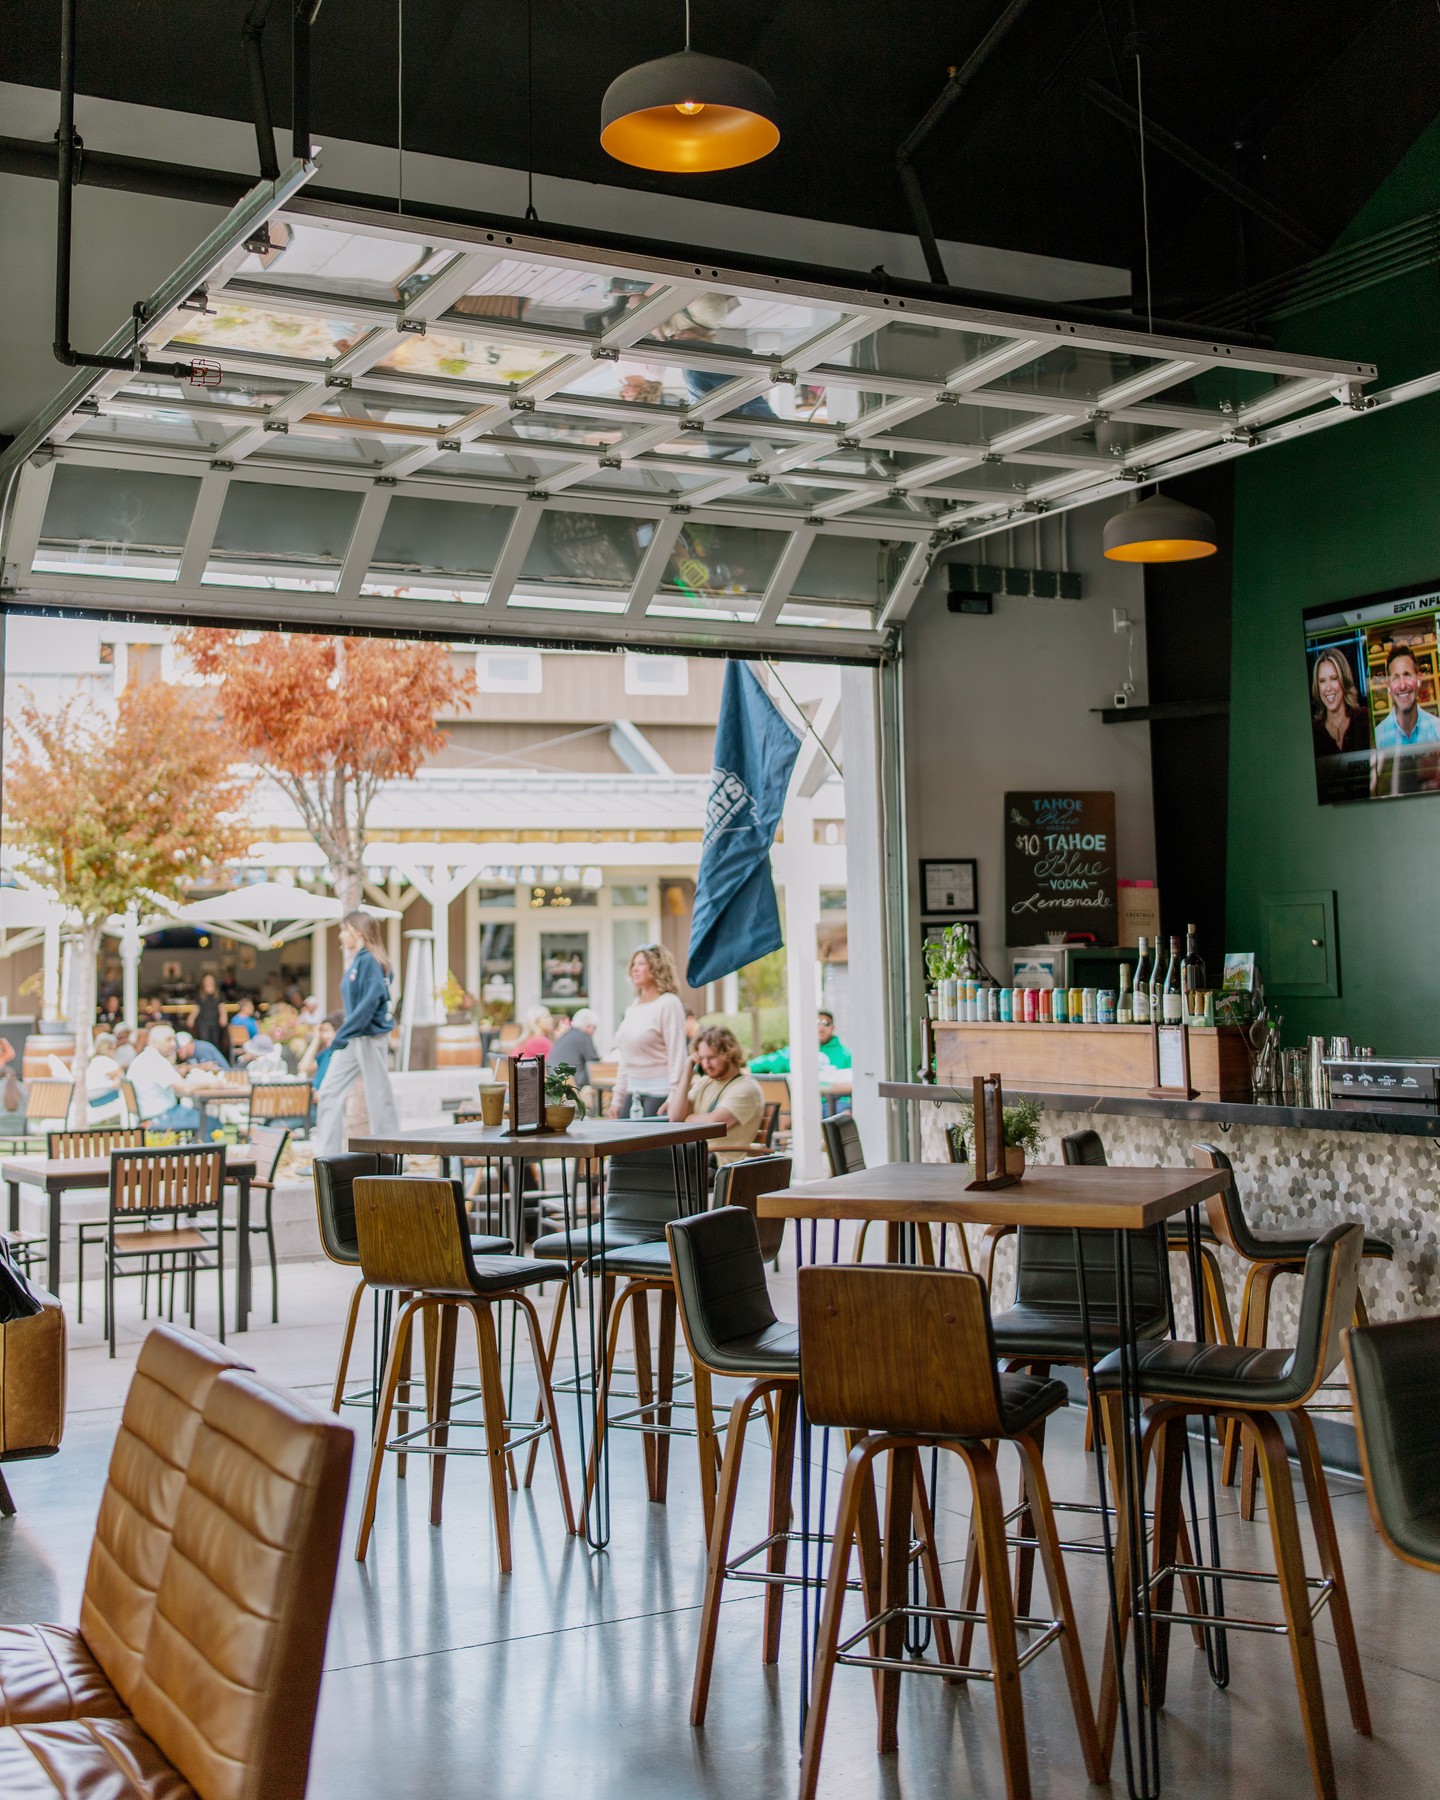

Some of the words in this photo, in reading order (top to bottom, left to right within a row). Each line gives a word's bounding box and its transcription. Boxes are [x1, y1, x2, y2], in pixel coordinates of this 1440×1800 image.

[1393, 601, 1416, 614] ESPN
[1419, 595, 1440, 608] NFL
[1033, 798, 1083, 811] TAHOE
[1034, 810, 1080, 825] Blue
[1015, 834, 1041, 855] $10
[1044, 832, 1107, 851] TAHOE
[1034, 851, 1110, 877] Blue
[1050, 879, 1089, 890] VODKA
[1011, 889, 1113, 915] Lemonade
